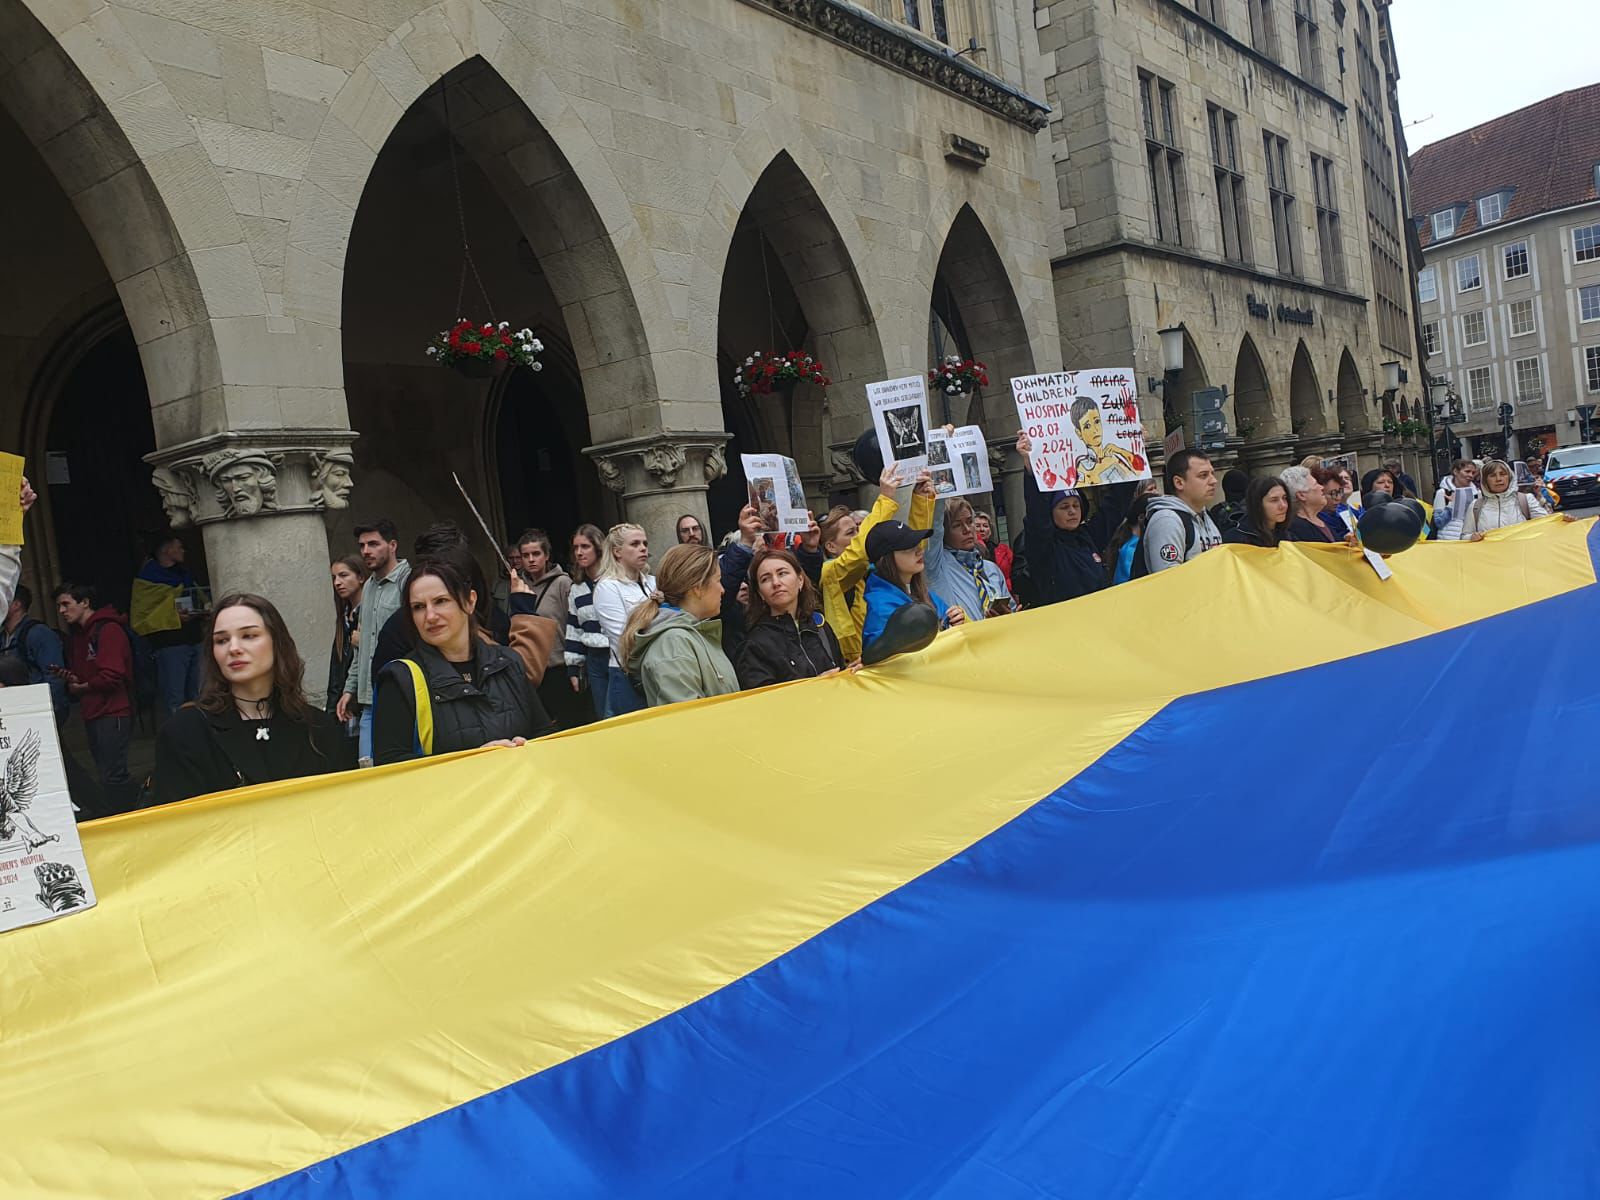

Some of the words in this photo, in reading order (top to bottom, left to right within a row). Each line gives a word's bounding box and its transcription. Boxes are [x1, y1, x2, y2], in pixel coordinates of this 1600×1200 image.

[1013, 371, 1080, 391] OKHMATDT
[1016, 385, 1078, 404] CHILDRENS
[1024, 402, 1071, 420] HOSPITAL
